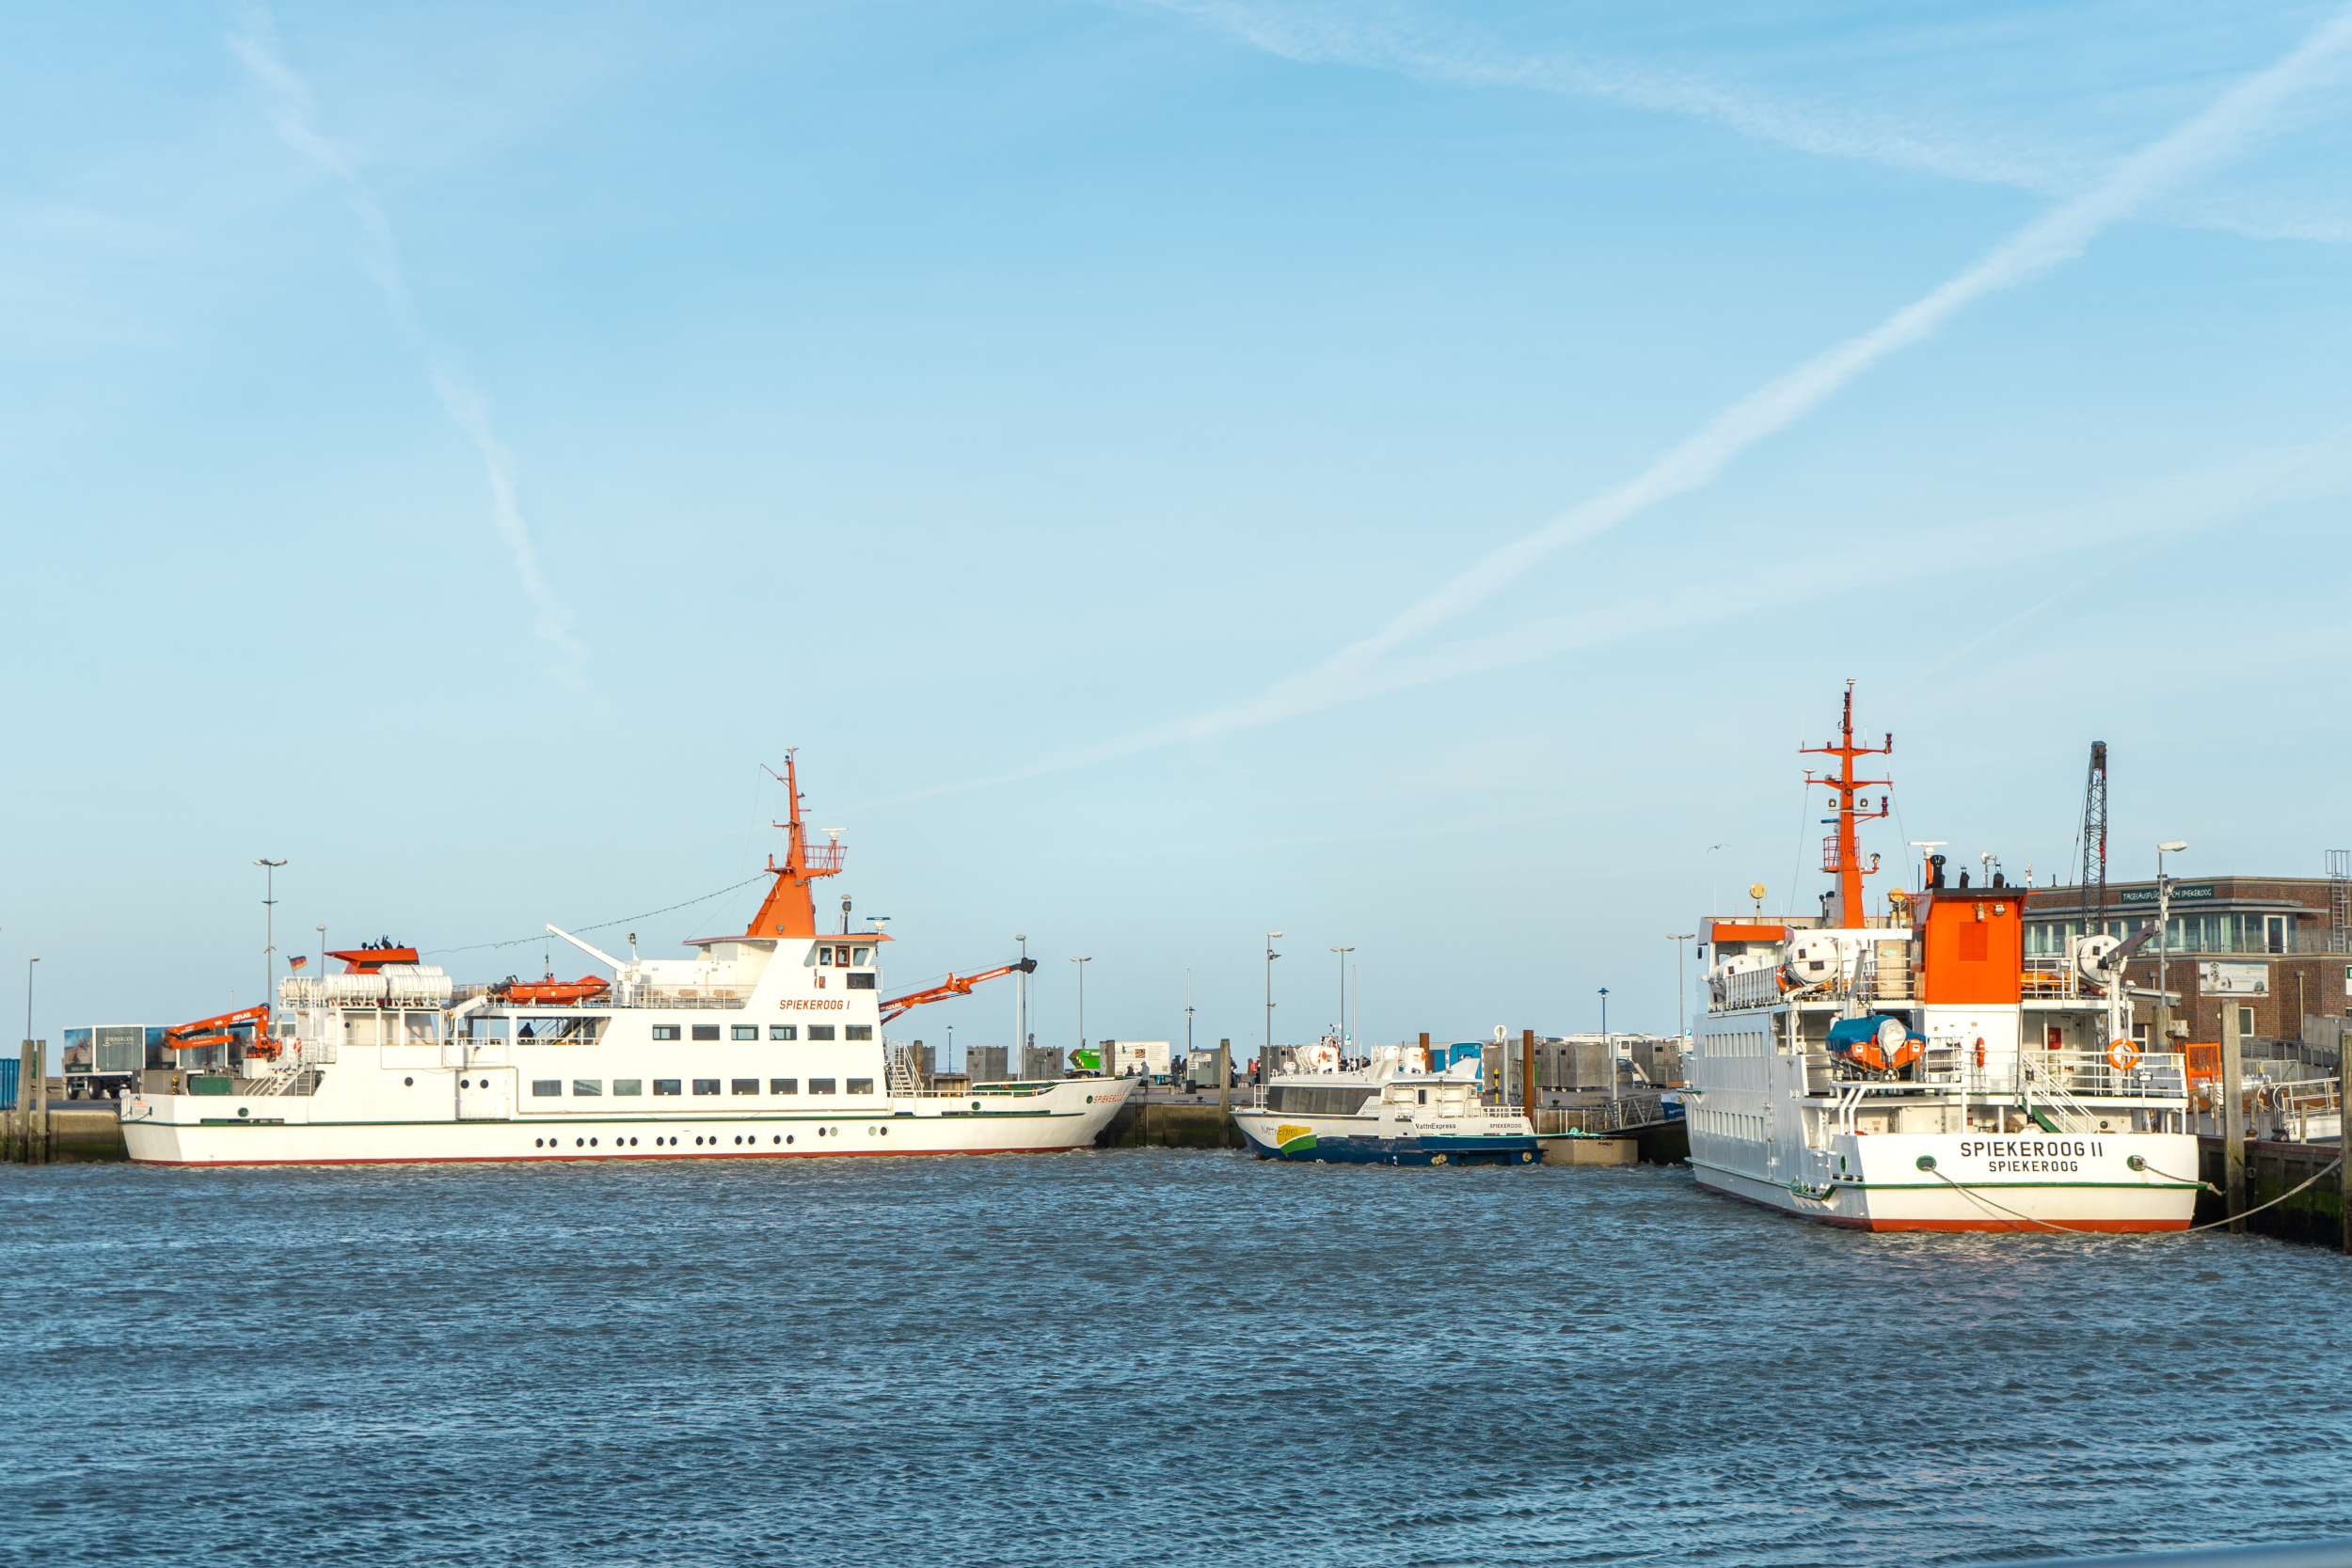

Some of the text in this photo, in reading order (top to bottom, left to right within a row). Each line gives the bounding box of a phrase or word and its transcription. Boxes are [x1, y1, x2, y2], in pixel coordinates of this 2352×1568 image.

[2181, 889, 2212, 898] SPIEKEROOG
[779, 999, 850, 1010] SPIEKEROOG I
[885, 1002, 902, 1011] ATLAS
[231, 1012, 251, 1022] ATLAS
[1961, 1141, 2104, 1157] SPIEKEROOG II
[1989, 1161, 2078, 1172] SPIEKEROOG
